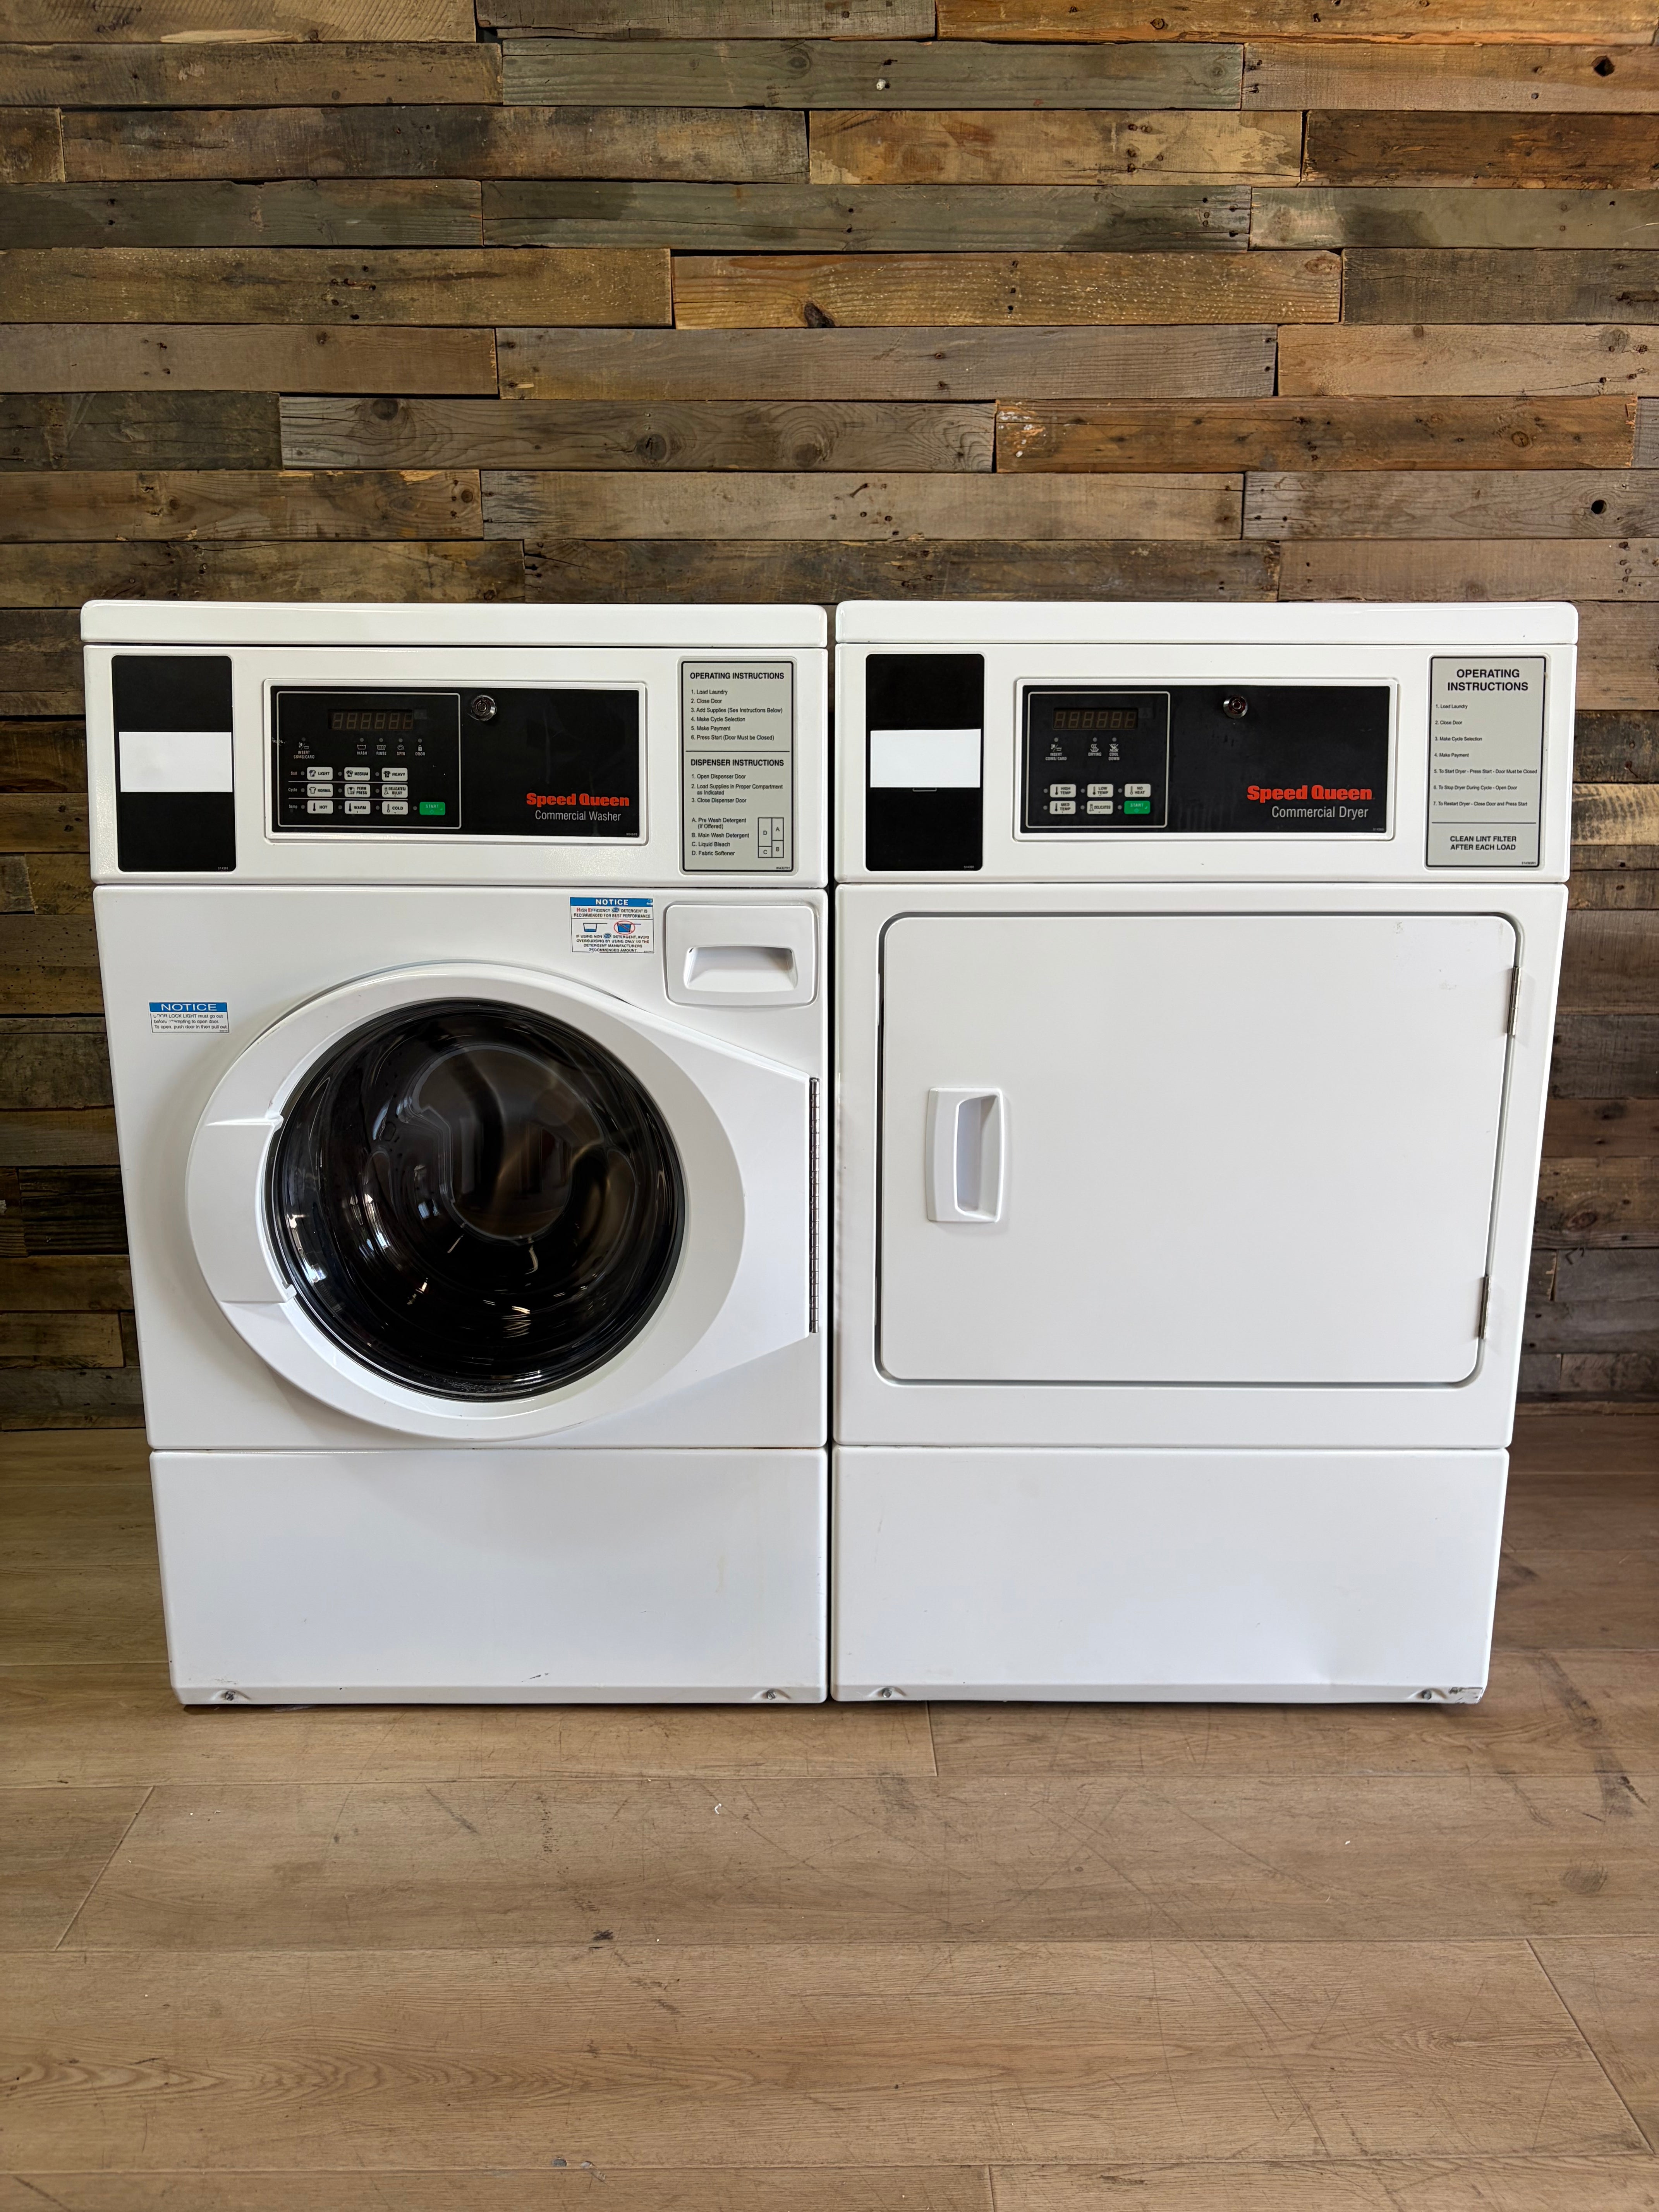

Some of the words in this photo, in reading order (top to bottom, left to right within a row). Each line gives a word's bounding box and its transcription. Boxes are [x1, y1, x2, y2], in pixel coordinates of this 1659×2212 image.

[1457, 669, 1519, 678] OPERATING
[1448, 682, 1528, 690] INSTRUCTIONS
[527, 793, 576, 807] Speed
[579, 793, 629, 806] Queen
[1247, 785, 1307, 803] Speed
[1311, 785, 1372, 800] Queen
[536, 810, 586, 820] Commercial
[589, 811, 621, 821] Washer
[1272, 806, 1335, 817] Commercial
[1340, 806, 1368, 820] Dryer
